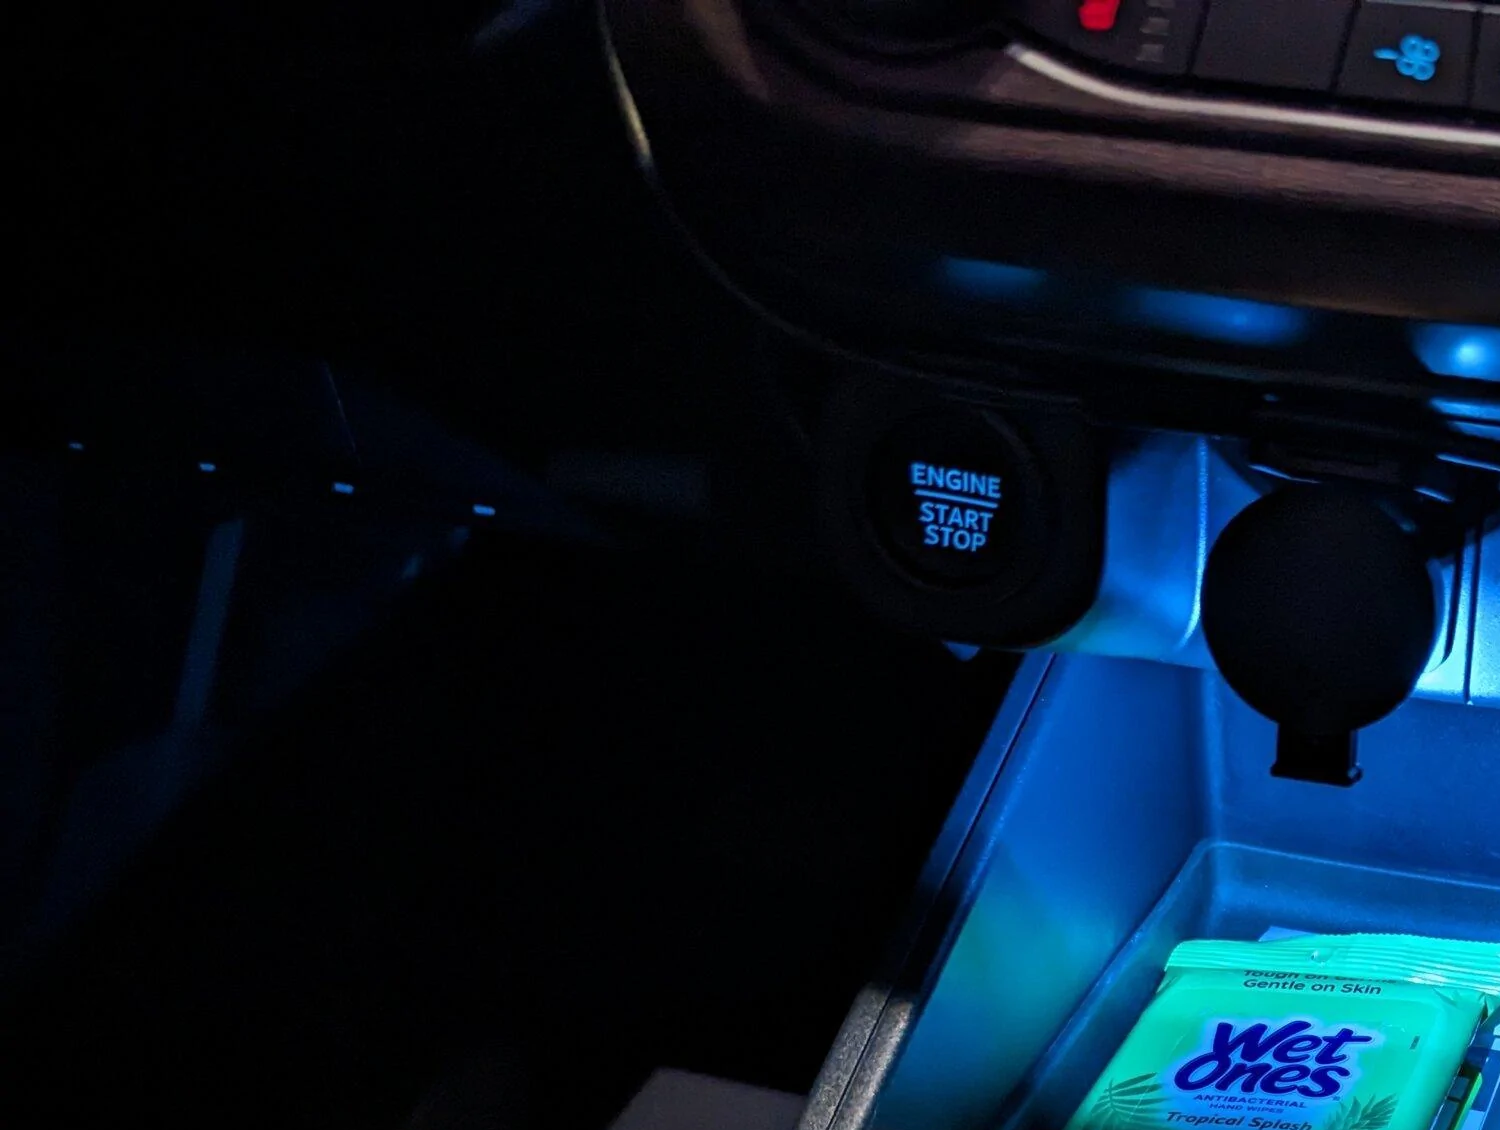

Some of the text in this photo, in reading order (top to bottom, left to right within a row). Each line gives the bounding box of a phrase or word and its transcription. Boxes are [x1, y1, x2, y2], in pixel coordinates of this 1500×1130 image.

[911, 462, 1001, 498] ENGINE
[919, 502, 993, 532] START
[924, 525, 986, 551] STOP
[1243, 978, 1382, 995] Gentle on Skin
[1213, 1020, 1373, 1065] Wet
[1174, 1051, 1351, 1098] Ones
[1194, 1094, 1307, 1109] ANTIBACTERIAL
[1209, 1103, 1284, 1114] HAND WIPES
[1166, 1111, 1244, 1126] Tropical
